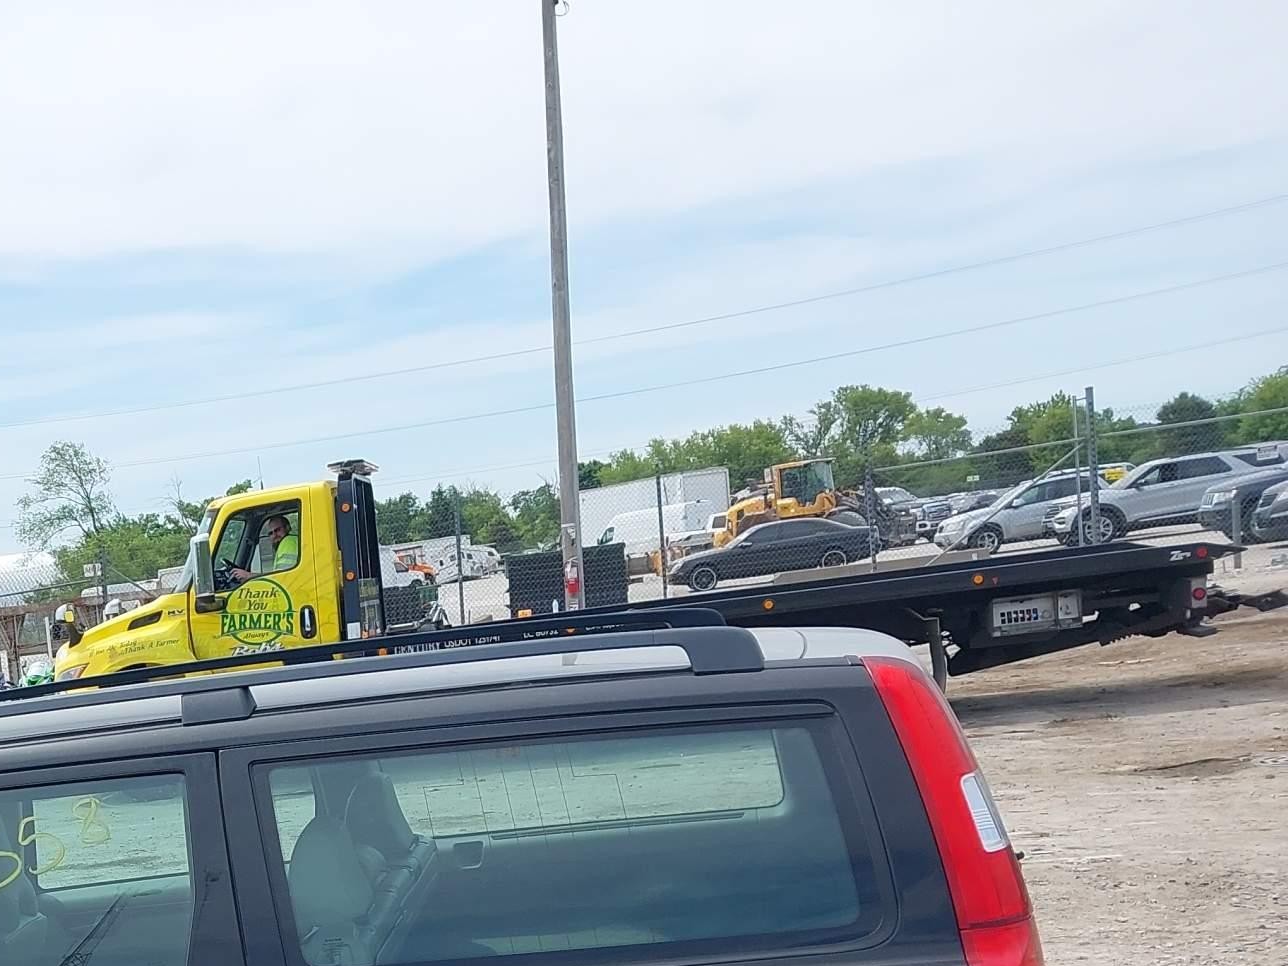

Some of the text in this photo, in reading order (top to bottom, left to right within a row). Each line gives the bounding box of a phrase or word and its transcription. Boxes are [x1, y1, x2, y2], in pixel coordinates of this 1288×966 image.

[237, 587, 279, 600] Thank
[247, 599, 268, 611] You
[220, 612, 294, 637] FARMER'S
